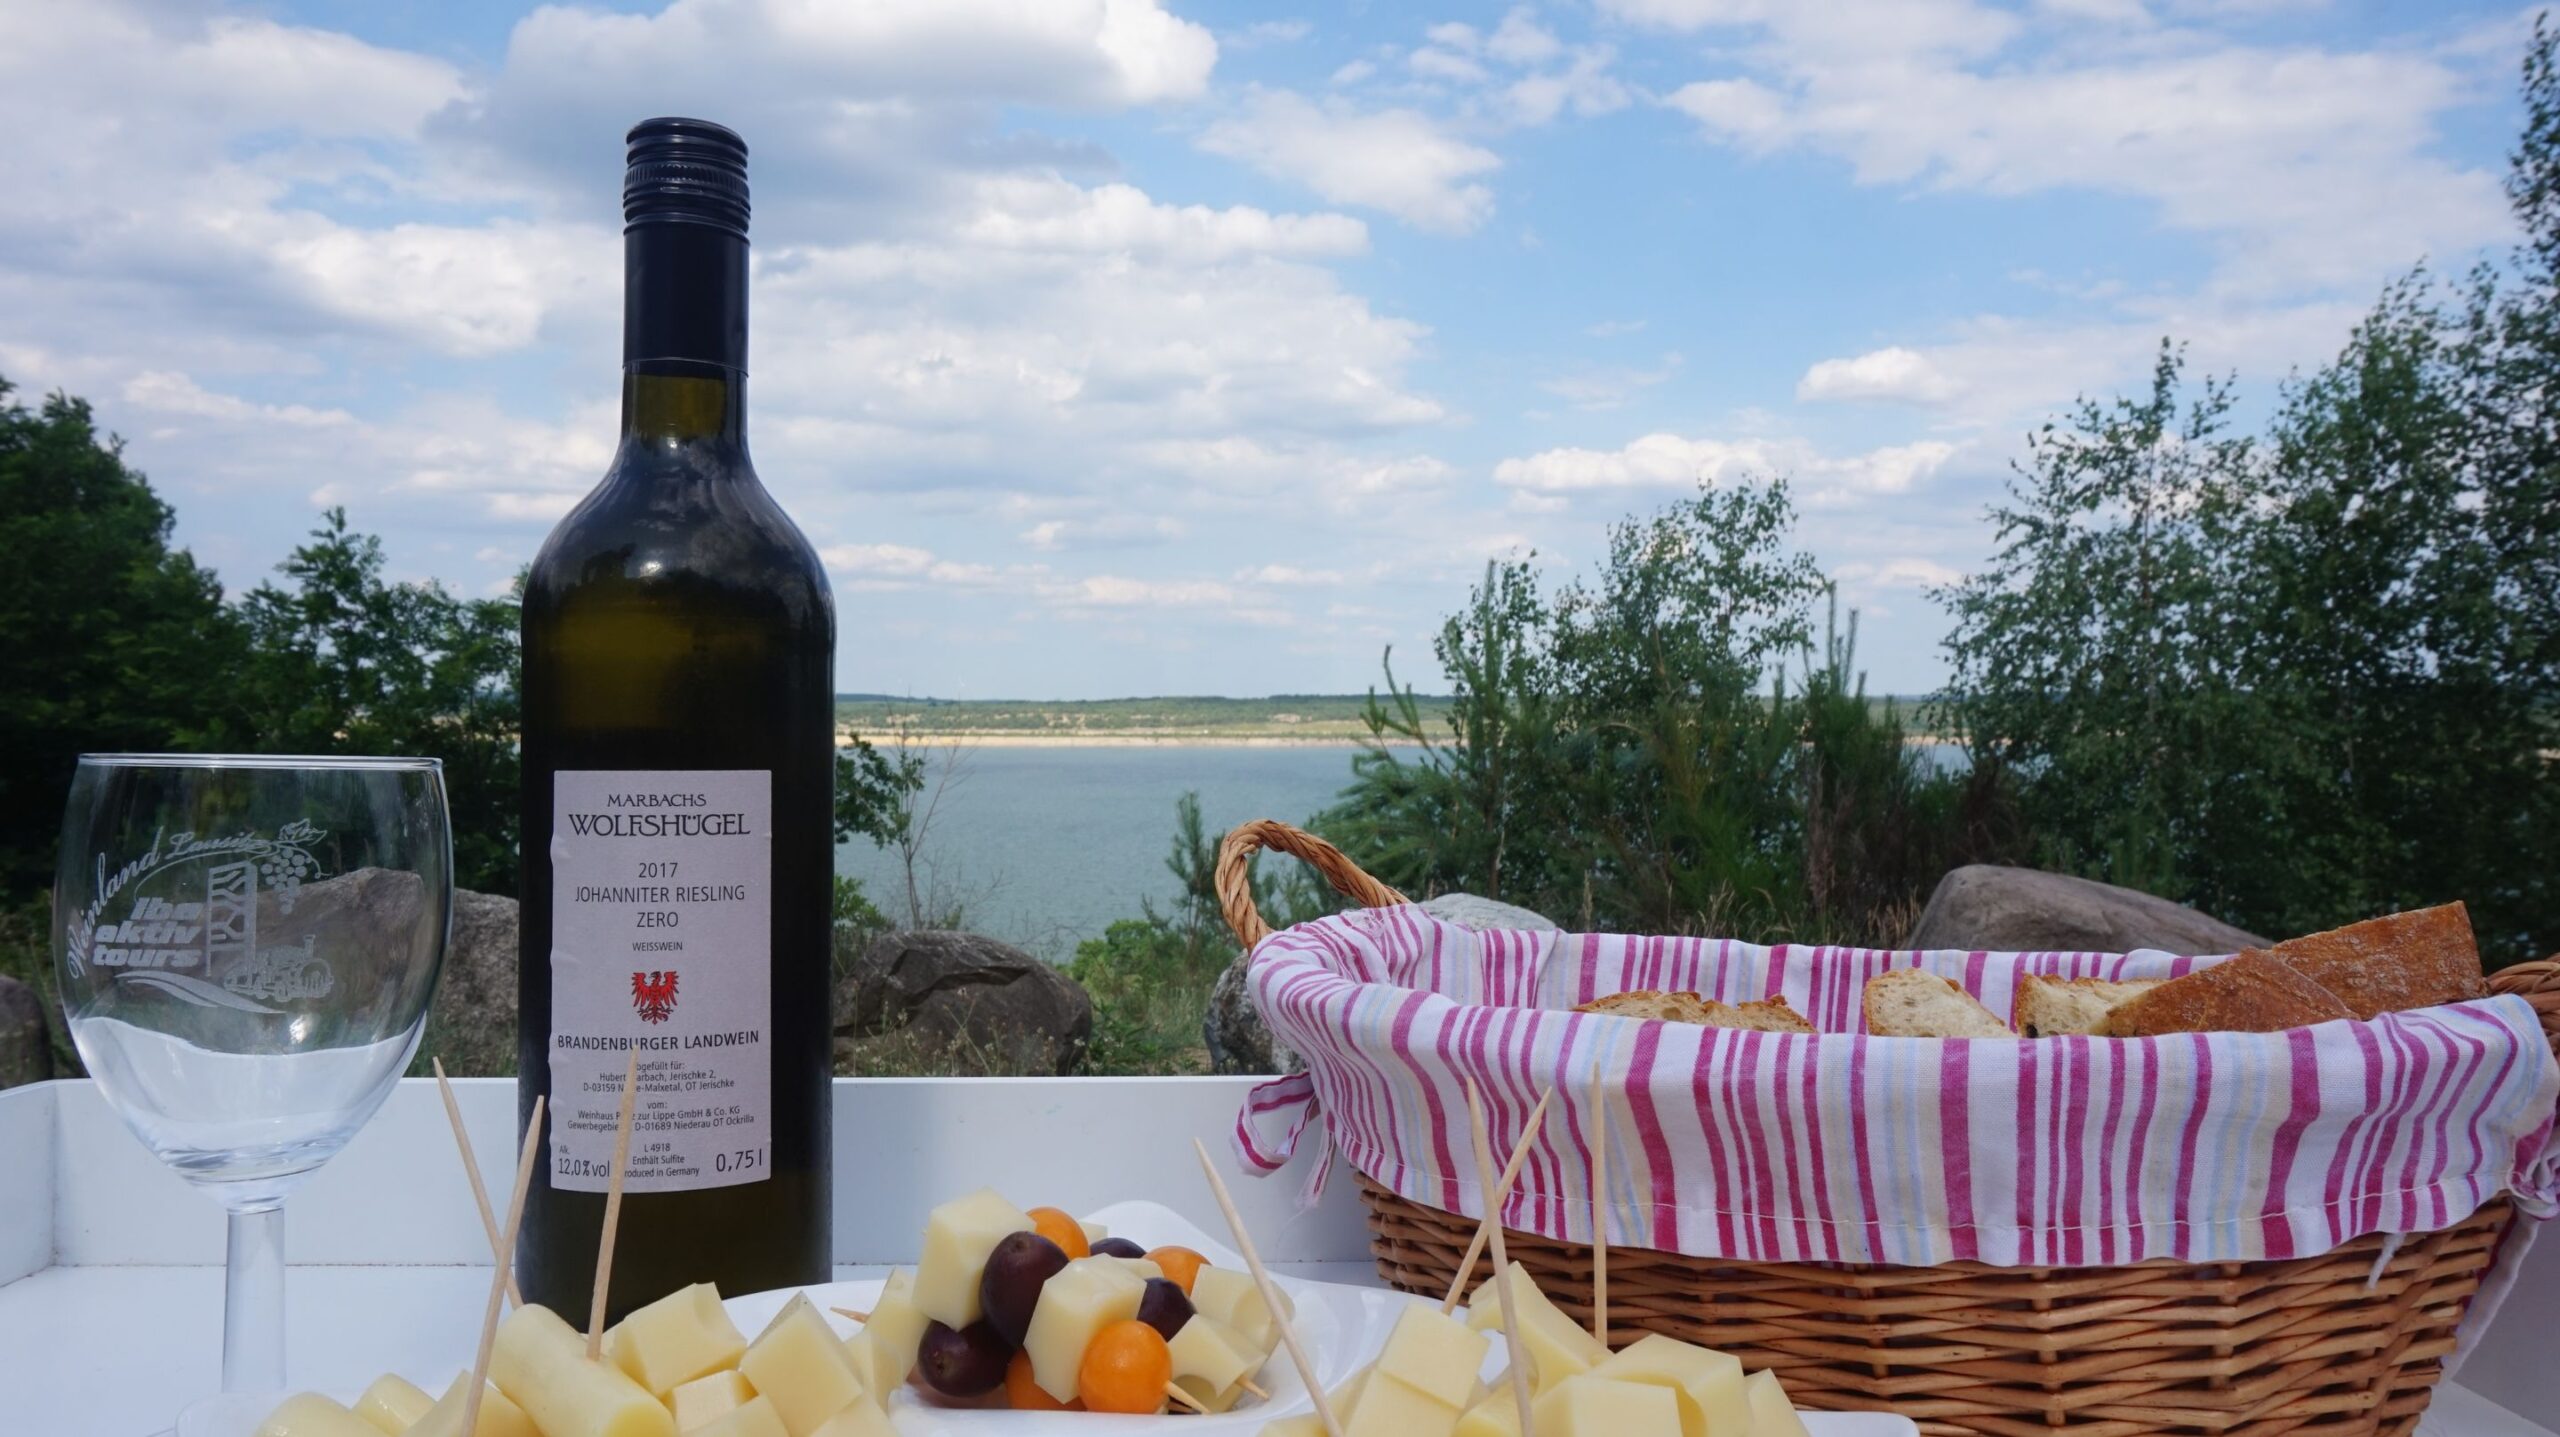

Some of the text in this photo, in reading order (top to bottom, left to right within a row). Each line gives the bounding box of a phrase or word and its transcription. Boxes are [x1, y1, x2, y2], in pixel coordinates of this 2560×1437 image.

[607, 794, 707, 807] MARBACHS
[568, 813, 751, 836] WOLFSHÜGEL
[638, 862, 678, 878] 2017
[575, 885, 745, 903] JOHANNITER RIESLING
[636, 912, 679, 928] ZERO
[632, 942, 683, 951] WEISSWEIN
[93, 944, 202, 967] tours
[557, 1030, 759, 1051] BRANDENBURGER LANDWEIN
[636, 1061, 668, 1073] bgefüllt
[599, 1073, 626, 1082] Hubert
[636, 1072, 667, 1083] arbach,
[583, 1083, 616, 1093] D-03159
[685, 1081, 697, 1092] OT
[700, 1079, 735, 1091] Jerischke
[646, 1101, 668, 1110] vom:
[578, 1110, 613, 1121] Weinhaus
[652, 1110, 675, 1122] Lippe
[677, 1108, 703, 1119] GmbH
[729, 1105, 740, 1115] KG
[567, 1120, 619, 1134] Gewerbegebie
[634, 1121, 671, 1131] D-01689
[713, 1118, 724, 1127] OT
[650, 1143, 671, 1152] 4918
[632, 1154, 685, 1166] Enthält Sulfite
[624, 1167, 700, 1178] roduced in Germany
